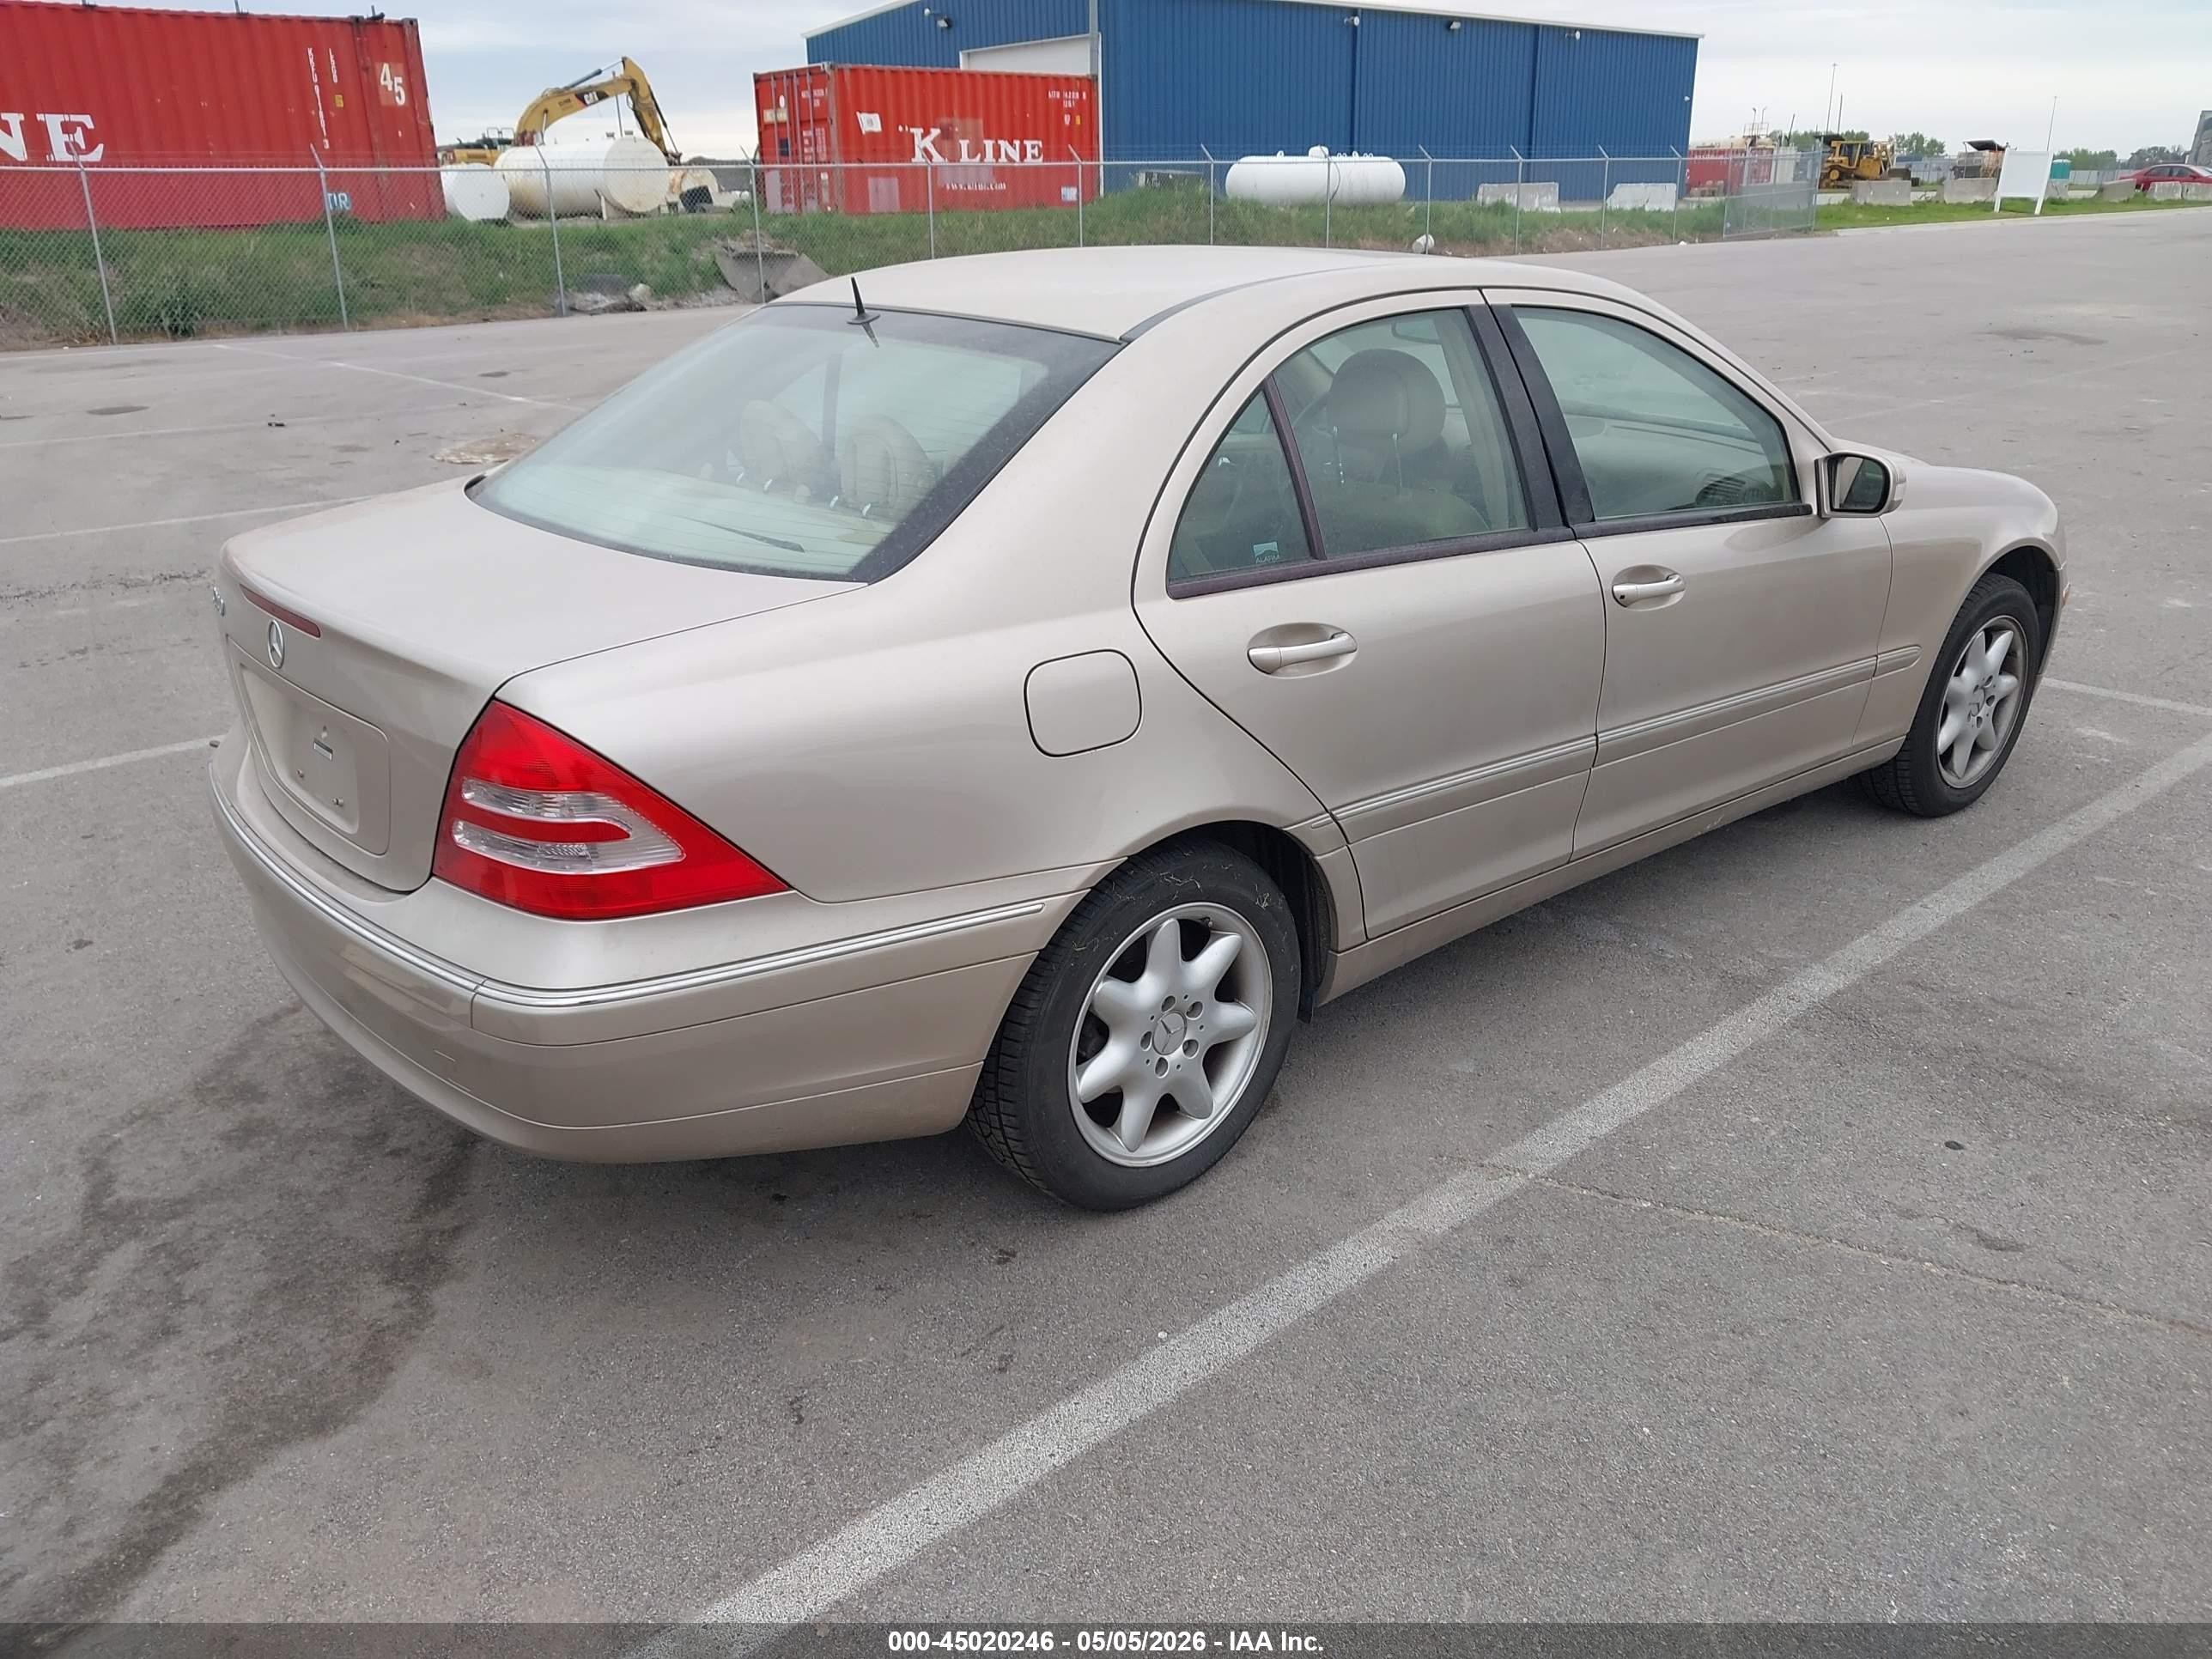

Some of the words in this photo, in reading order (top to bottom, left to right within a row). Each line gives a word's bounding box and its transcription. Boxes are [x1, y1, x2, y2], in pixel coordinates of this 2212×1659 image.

[380, 62, 406, 106] 45
[583, 92, 599, 104] CAT
[958, 139, 1044, 163] LINE
[326, 192, 350, 211] TIR
[1255, 554, 1279, 564] ALARM
